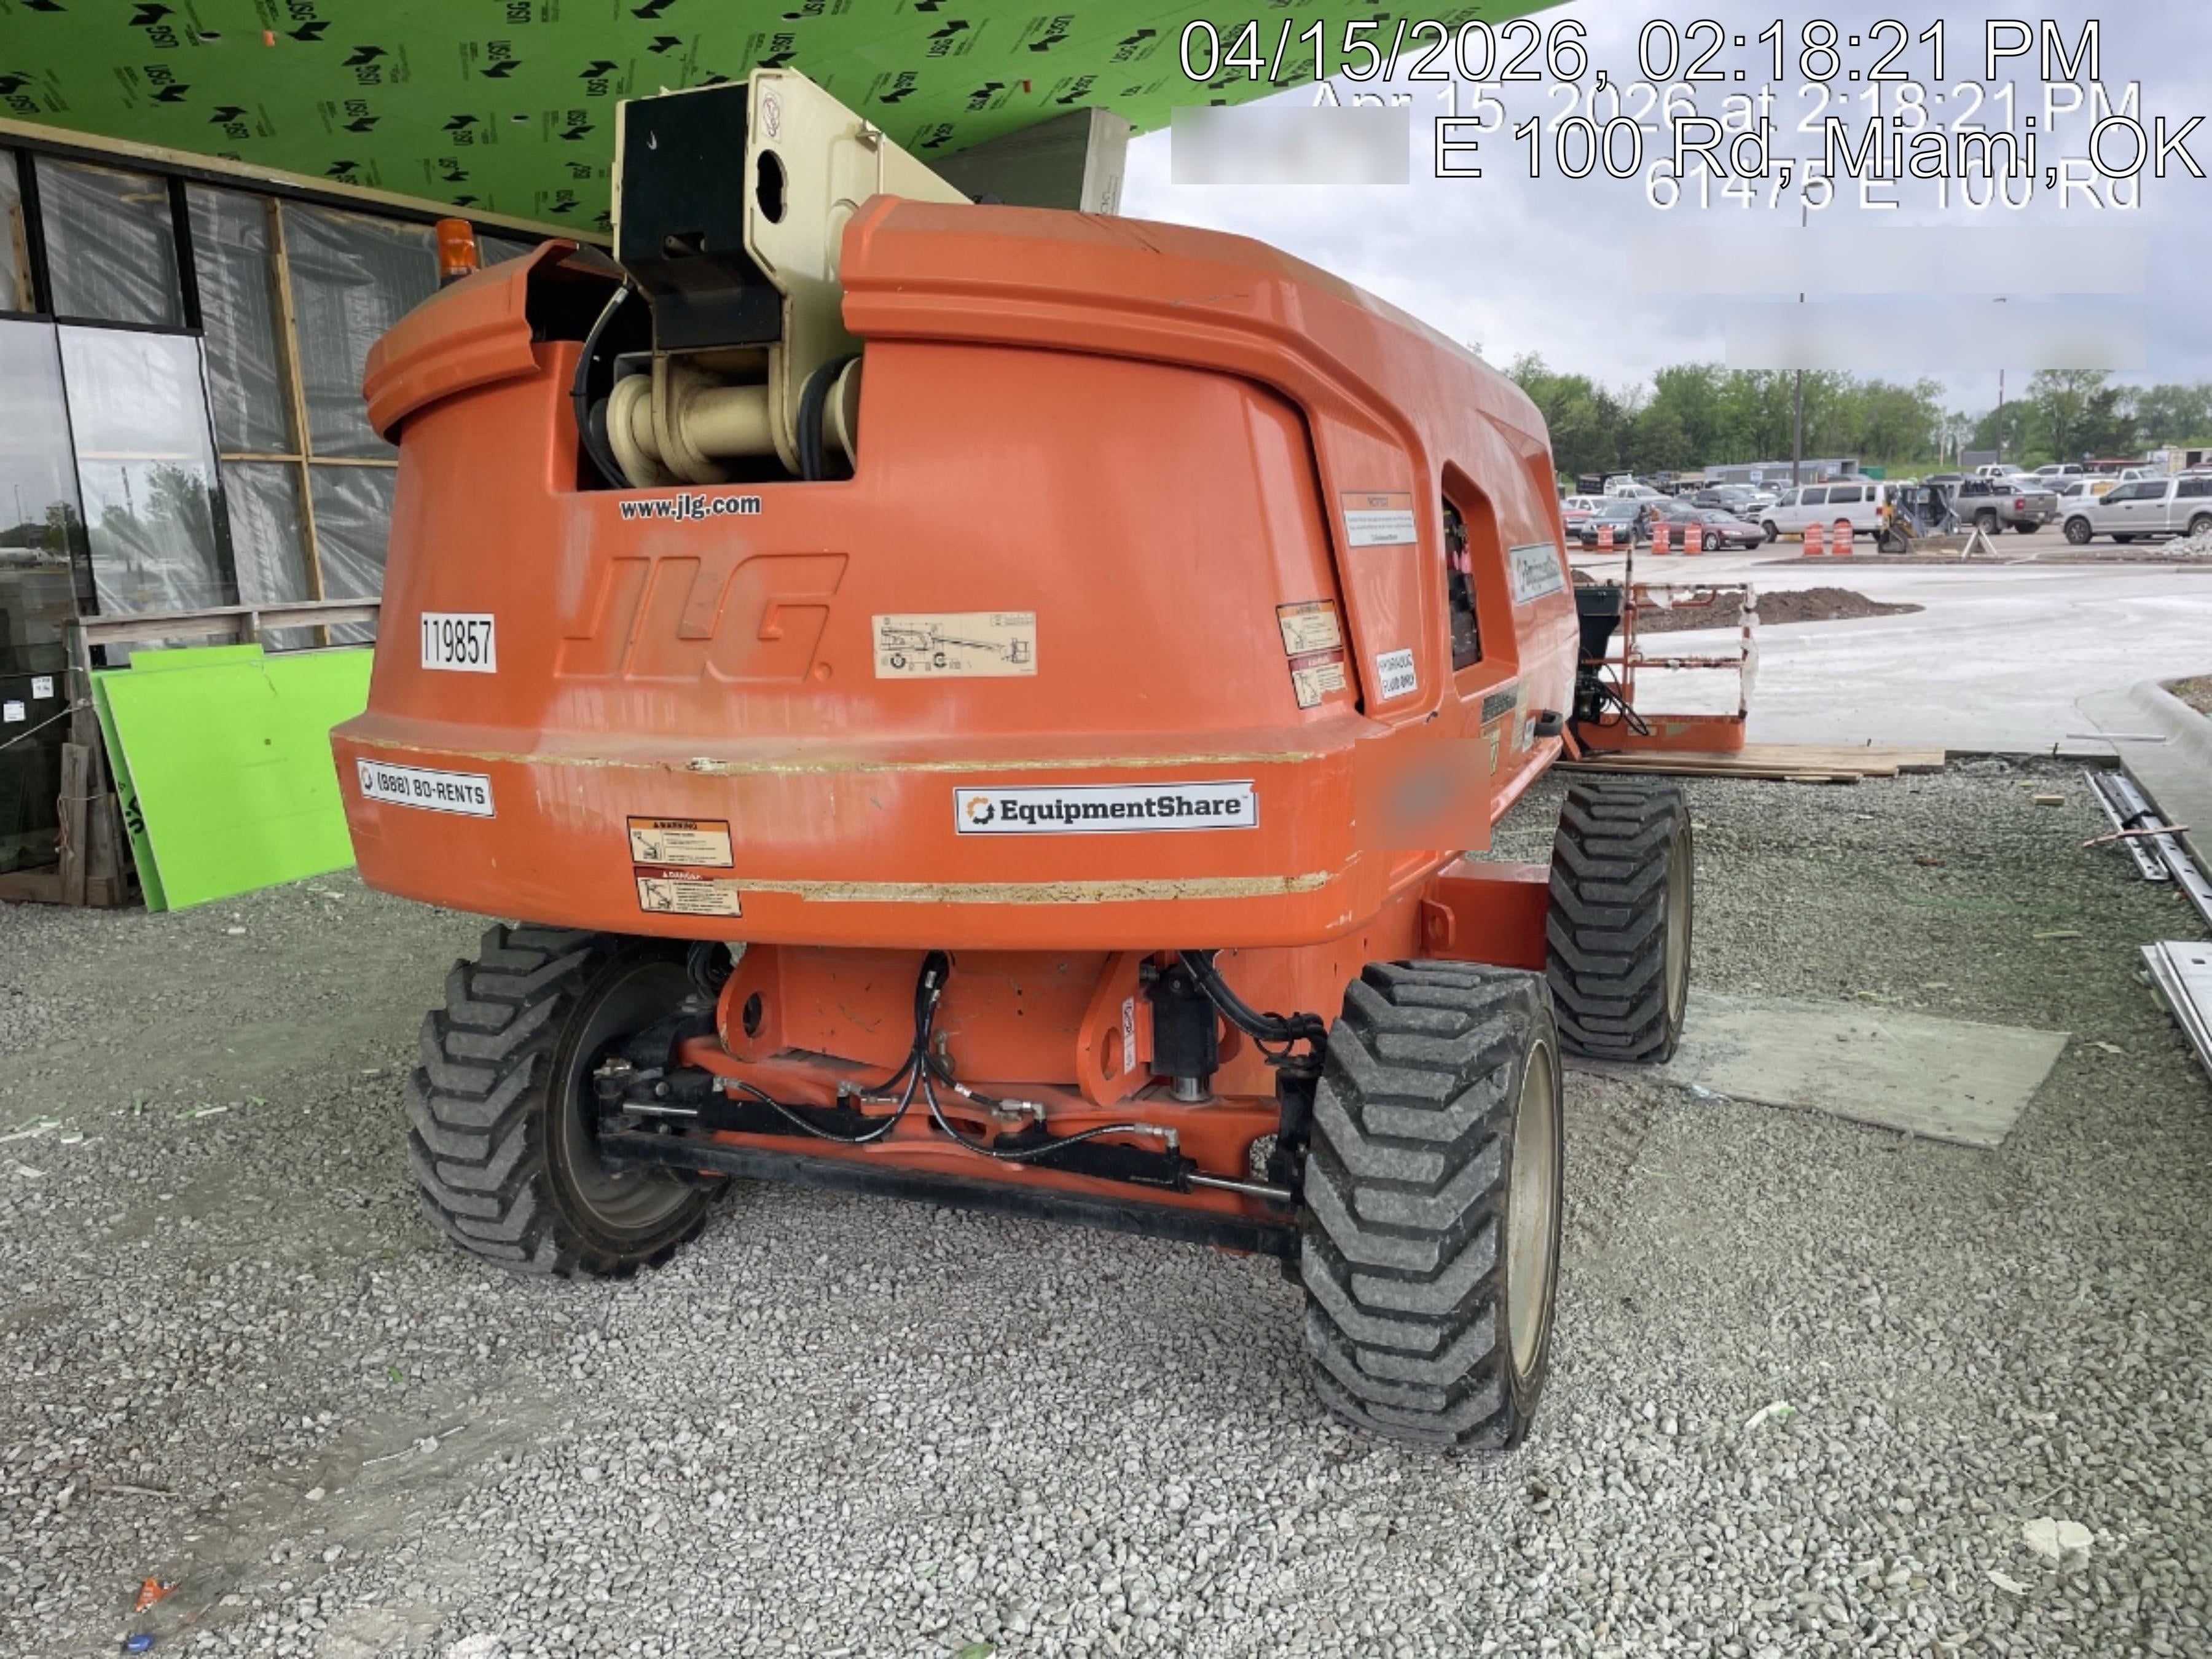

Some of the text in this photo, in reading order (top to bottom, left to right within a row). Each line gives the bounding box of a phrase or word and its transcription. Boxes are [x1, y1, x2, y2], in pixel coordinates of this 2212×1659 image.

[506, 1, 531, 24] USG
[487, 40, 511, 61] USG
[355, 64, 381, 85] USG
[586, 78, 608, 96] USG
[619, 494, 761, 521] www.jlg.com
[553, 552, 849, 683] JLG
[423, 619, 492, 664] 119857
[1000, 794, 1241, 825] EquipmentShare
